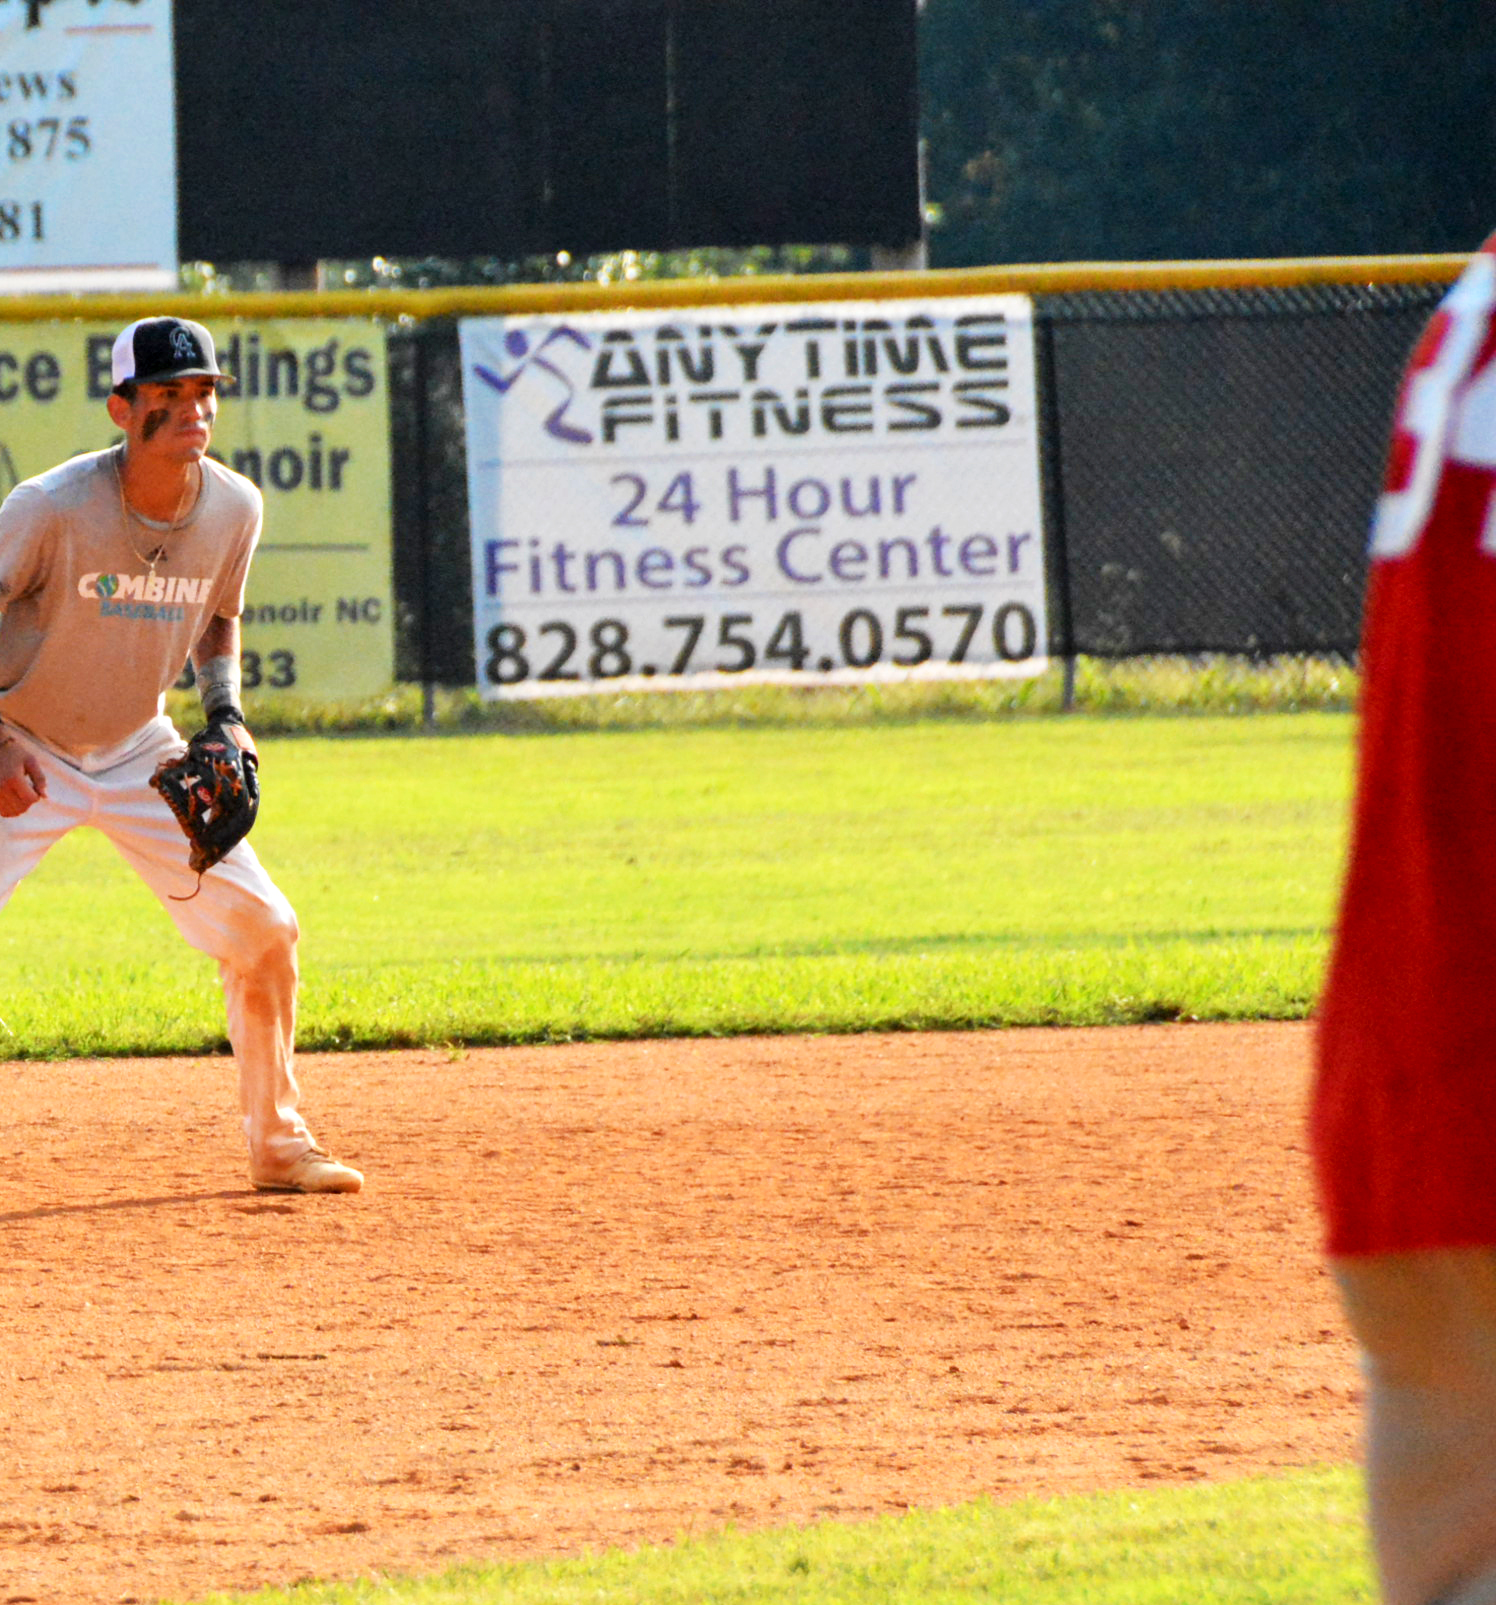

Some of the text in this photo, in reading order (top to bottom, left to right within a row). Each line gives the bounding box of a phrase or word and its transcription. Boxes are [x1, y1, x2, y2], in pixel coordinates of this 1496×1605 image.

[86, 332, 376, 414] Bdings
[590, 314, 1010, 389] ANYTIME
[603, 378, 1011, 443] FITNESS
[609, 465, 917, 528] 24 Hour
[484, 526, 1032, 596] Fitness Center
[242, 597, 381, 625] enoir NC
[485, 601, 1039, 685] 828.754.0570
